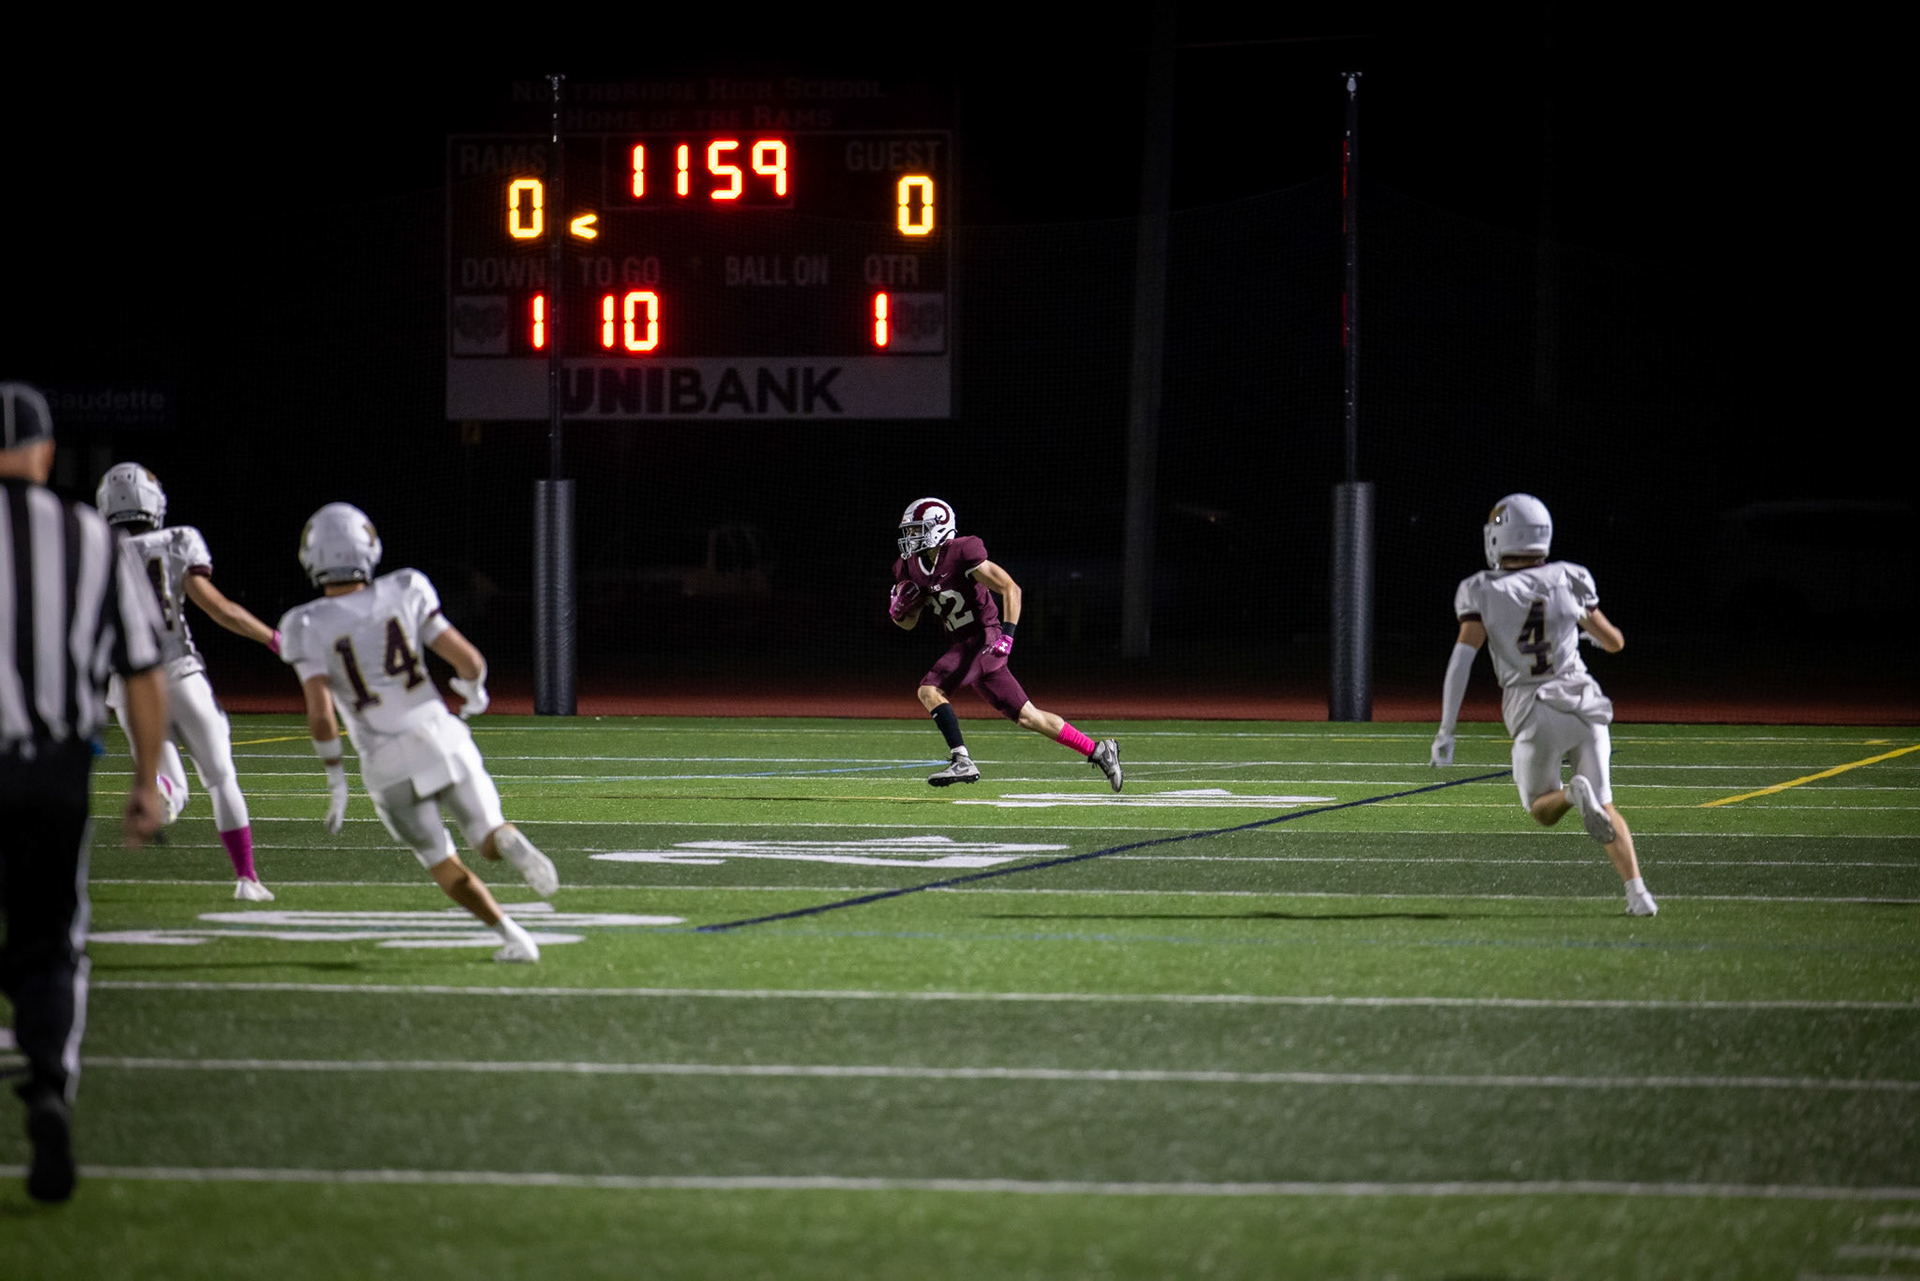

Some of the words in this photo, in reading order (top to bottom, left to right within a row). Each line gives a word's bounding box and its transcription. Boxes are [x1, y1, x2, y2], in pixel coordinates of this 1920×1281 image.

[511, 79, 698, 102] NOTHBRIDGE
[459, 143, 549, 175] RAMS
[844, 140, 942, 172] GUEST
[509, 179, 543, 238] 0
[898, 175, 934, 235] 0
[461, 256, 547, 288] DOWN
[577, 256, 613, 288] TO
[622, 255, 661, 286] GO
[724, 254, 788, 287] BALL
[794, 254, 829, 286] ON
[864, 253, 920, 286] QTR
[532, 294, 545, 348] 1
[603, 290, 659, 351] 10
[874, 292, 889, 347] 1
[560, 366, 843, 413] UNIBANK
[1516, 599, 1556, 677] 4
[334, 616, 425, 712] 14
